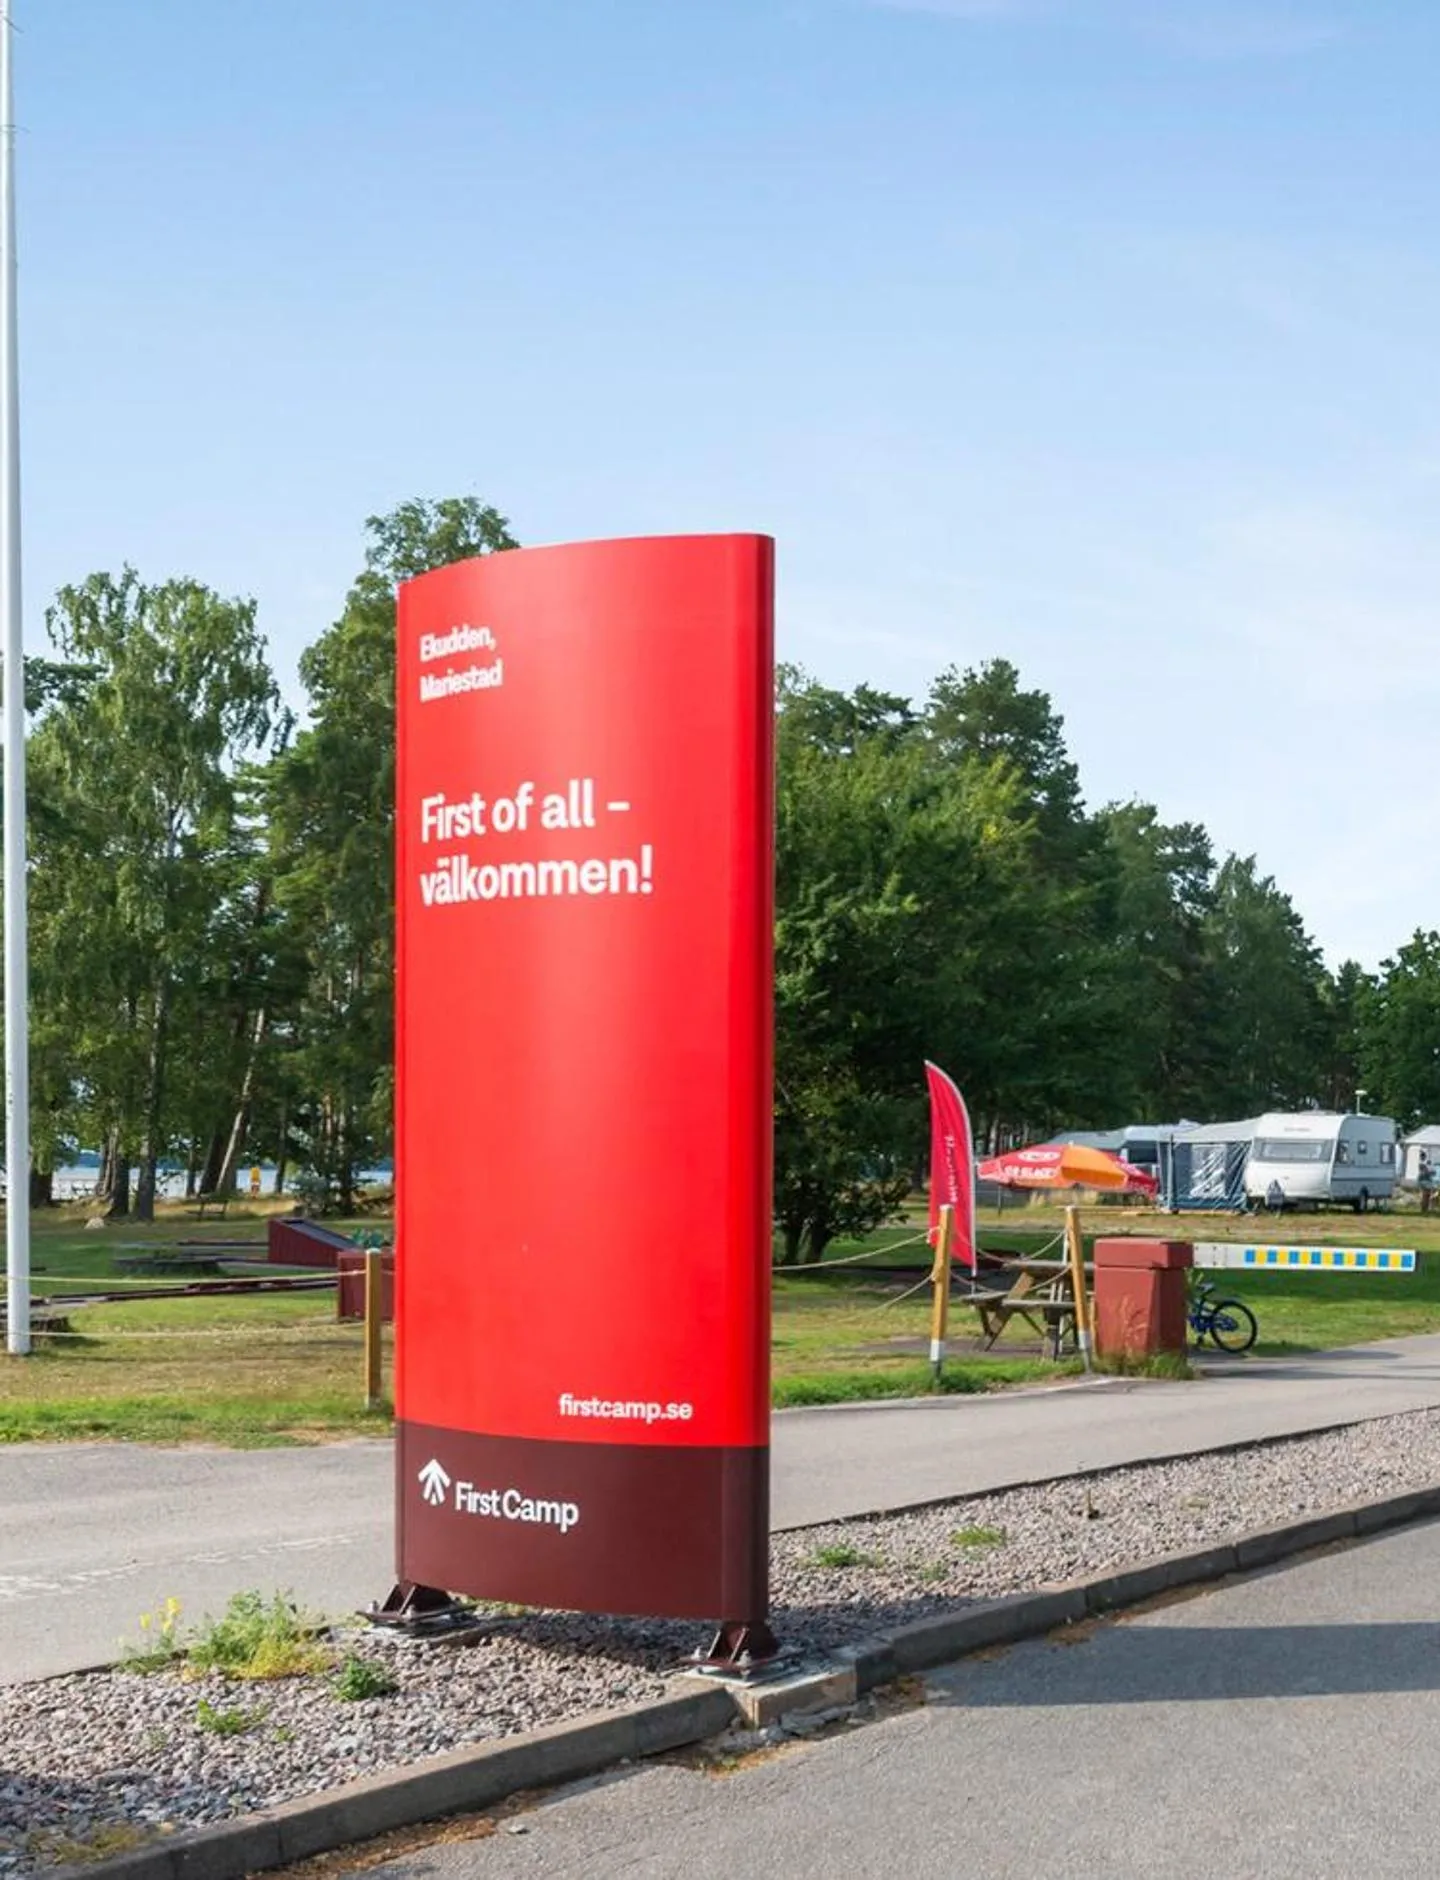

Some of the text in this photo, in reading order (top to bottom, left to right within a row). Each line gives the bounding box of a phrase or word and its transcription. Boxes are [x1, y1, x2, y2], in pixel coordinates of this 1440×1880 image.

[420, 658, 503, 702] Mariestad
[420, 792, 487, 843] First
[491, 781, 535, 832] of
[541, 778, 596, 828] all
[420, 844, 653, 906] välkommen!
[559, 1392, 693, 1424] firstcamp.se
